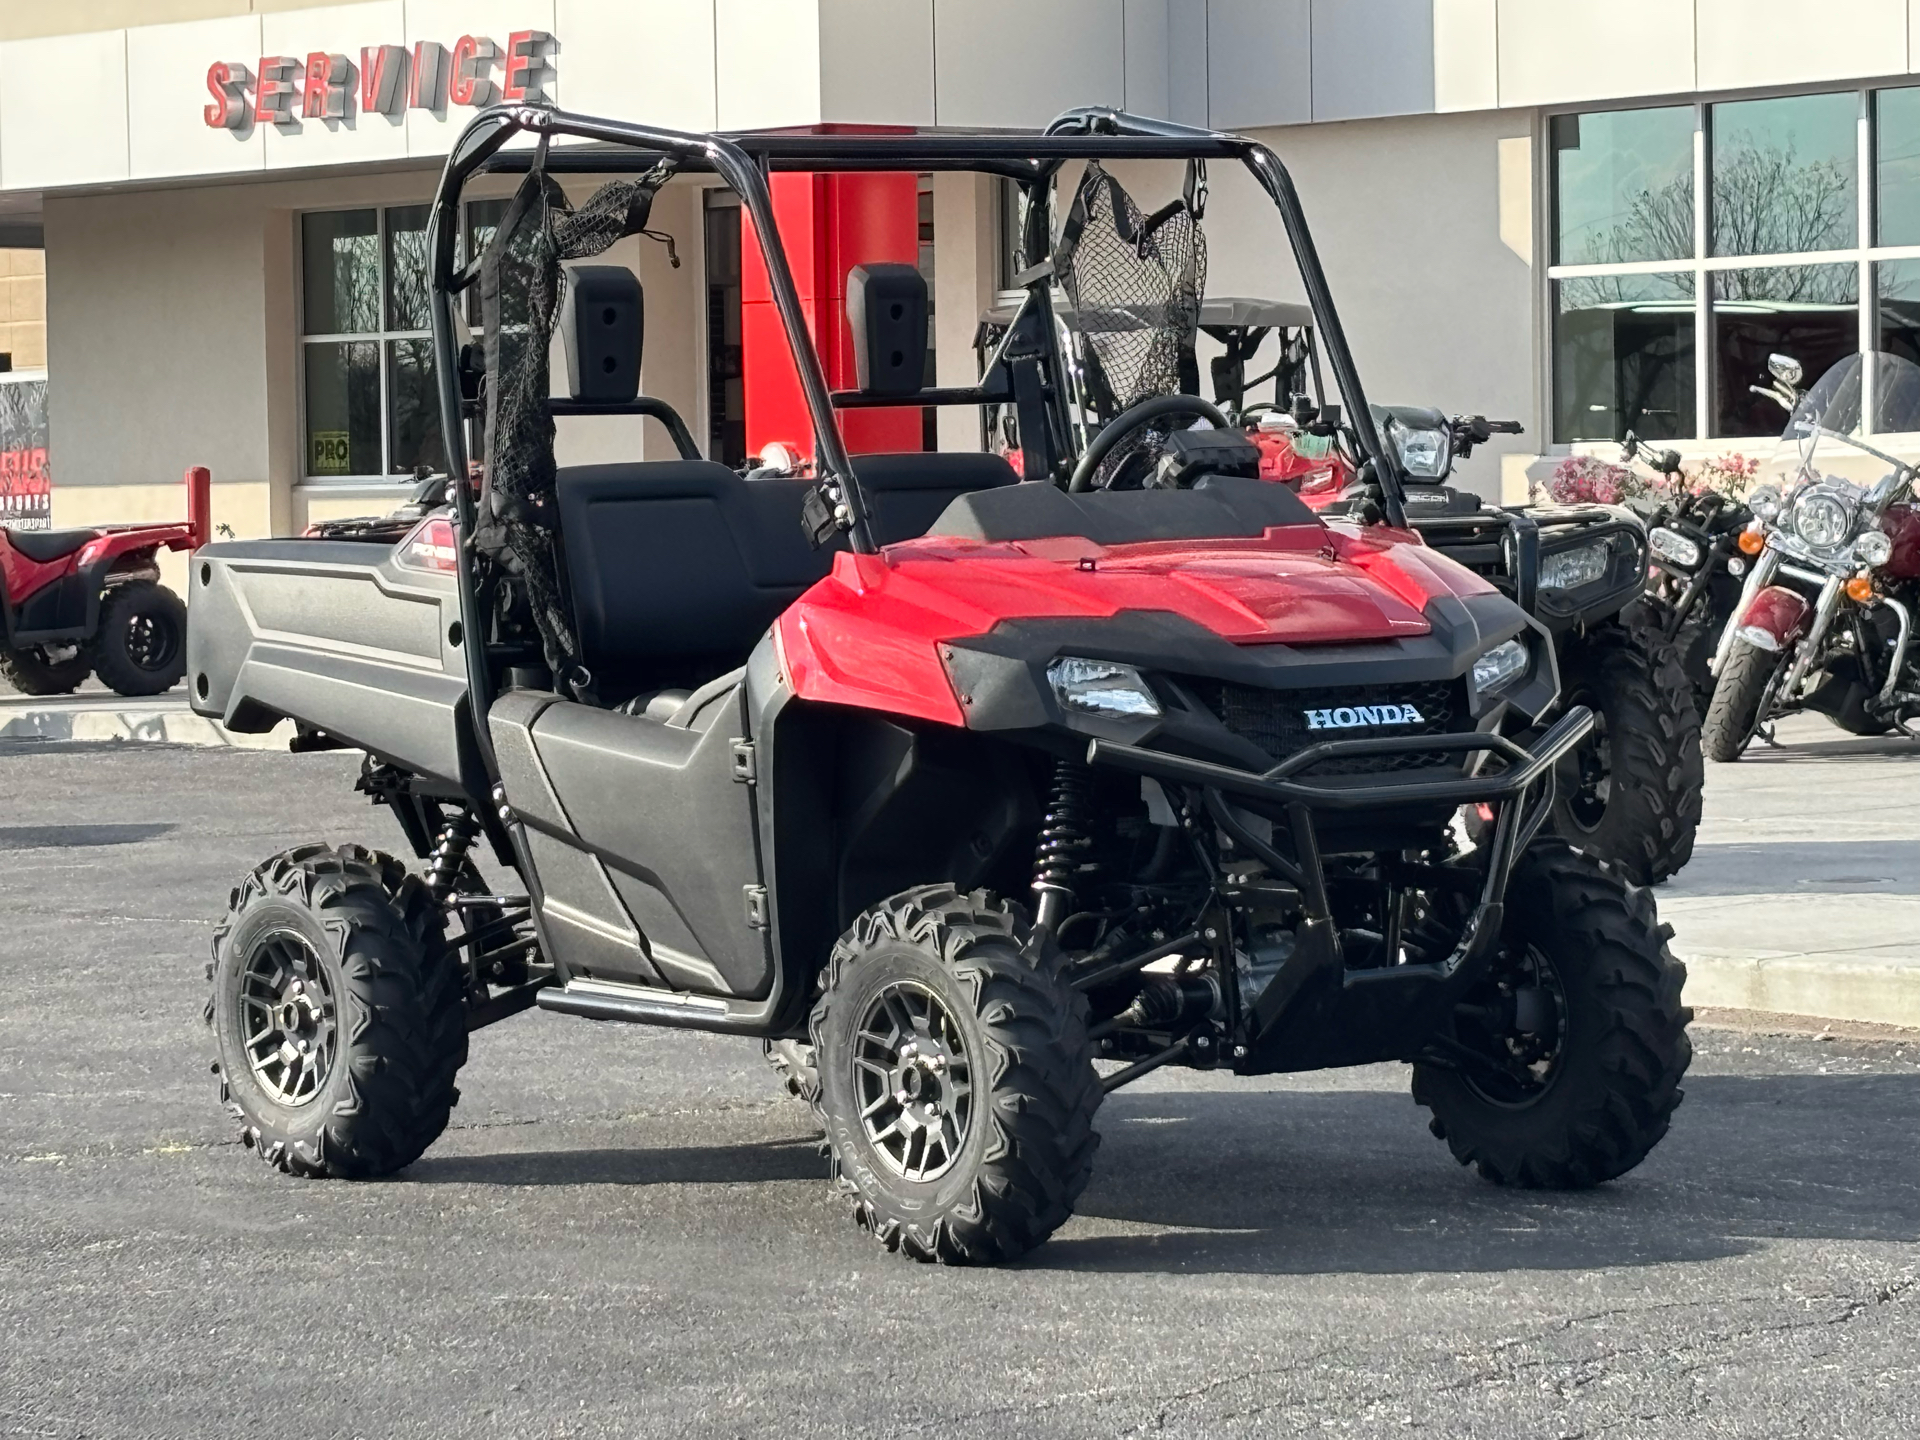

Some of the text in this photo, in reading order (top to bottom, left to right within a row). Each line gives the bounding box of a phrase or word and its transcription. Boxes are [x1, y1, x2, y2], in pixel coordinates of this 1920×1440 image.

[204, 30, 548, 129] SERVICE
[314, 439, 348, 460] PRO
[1303, 703, 1425, 729] HONDA
